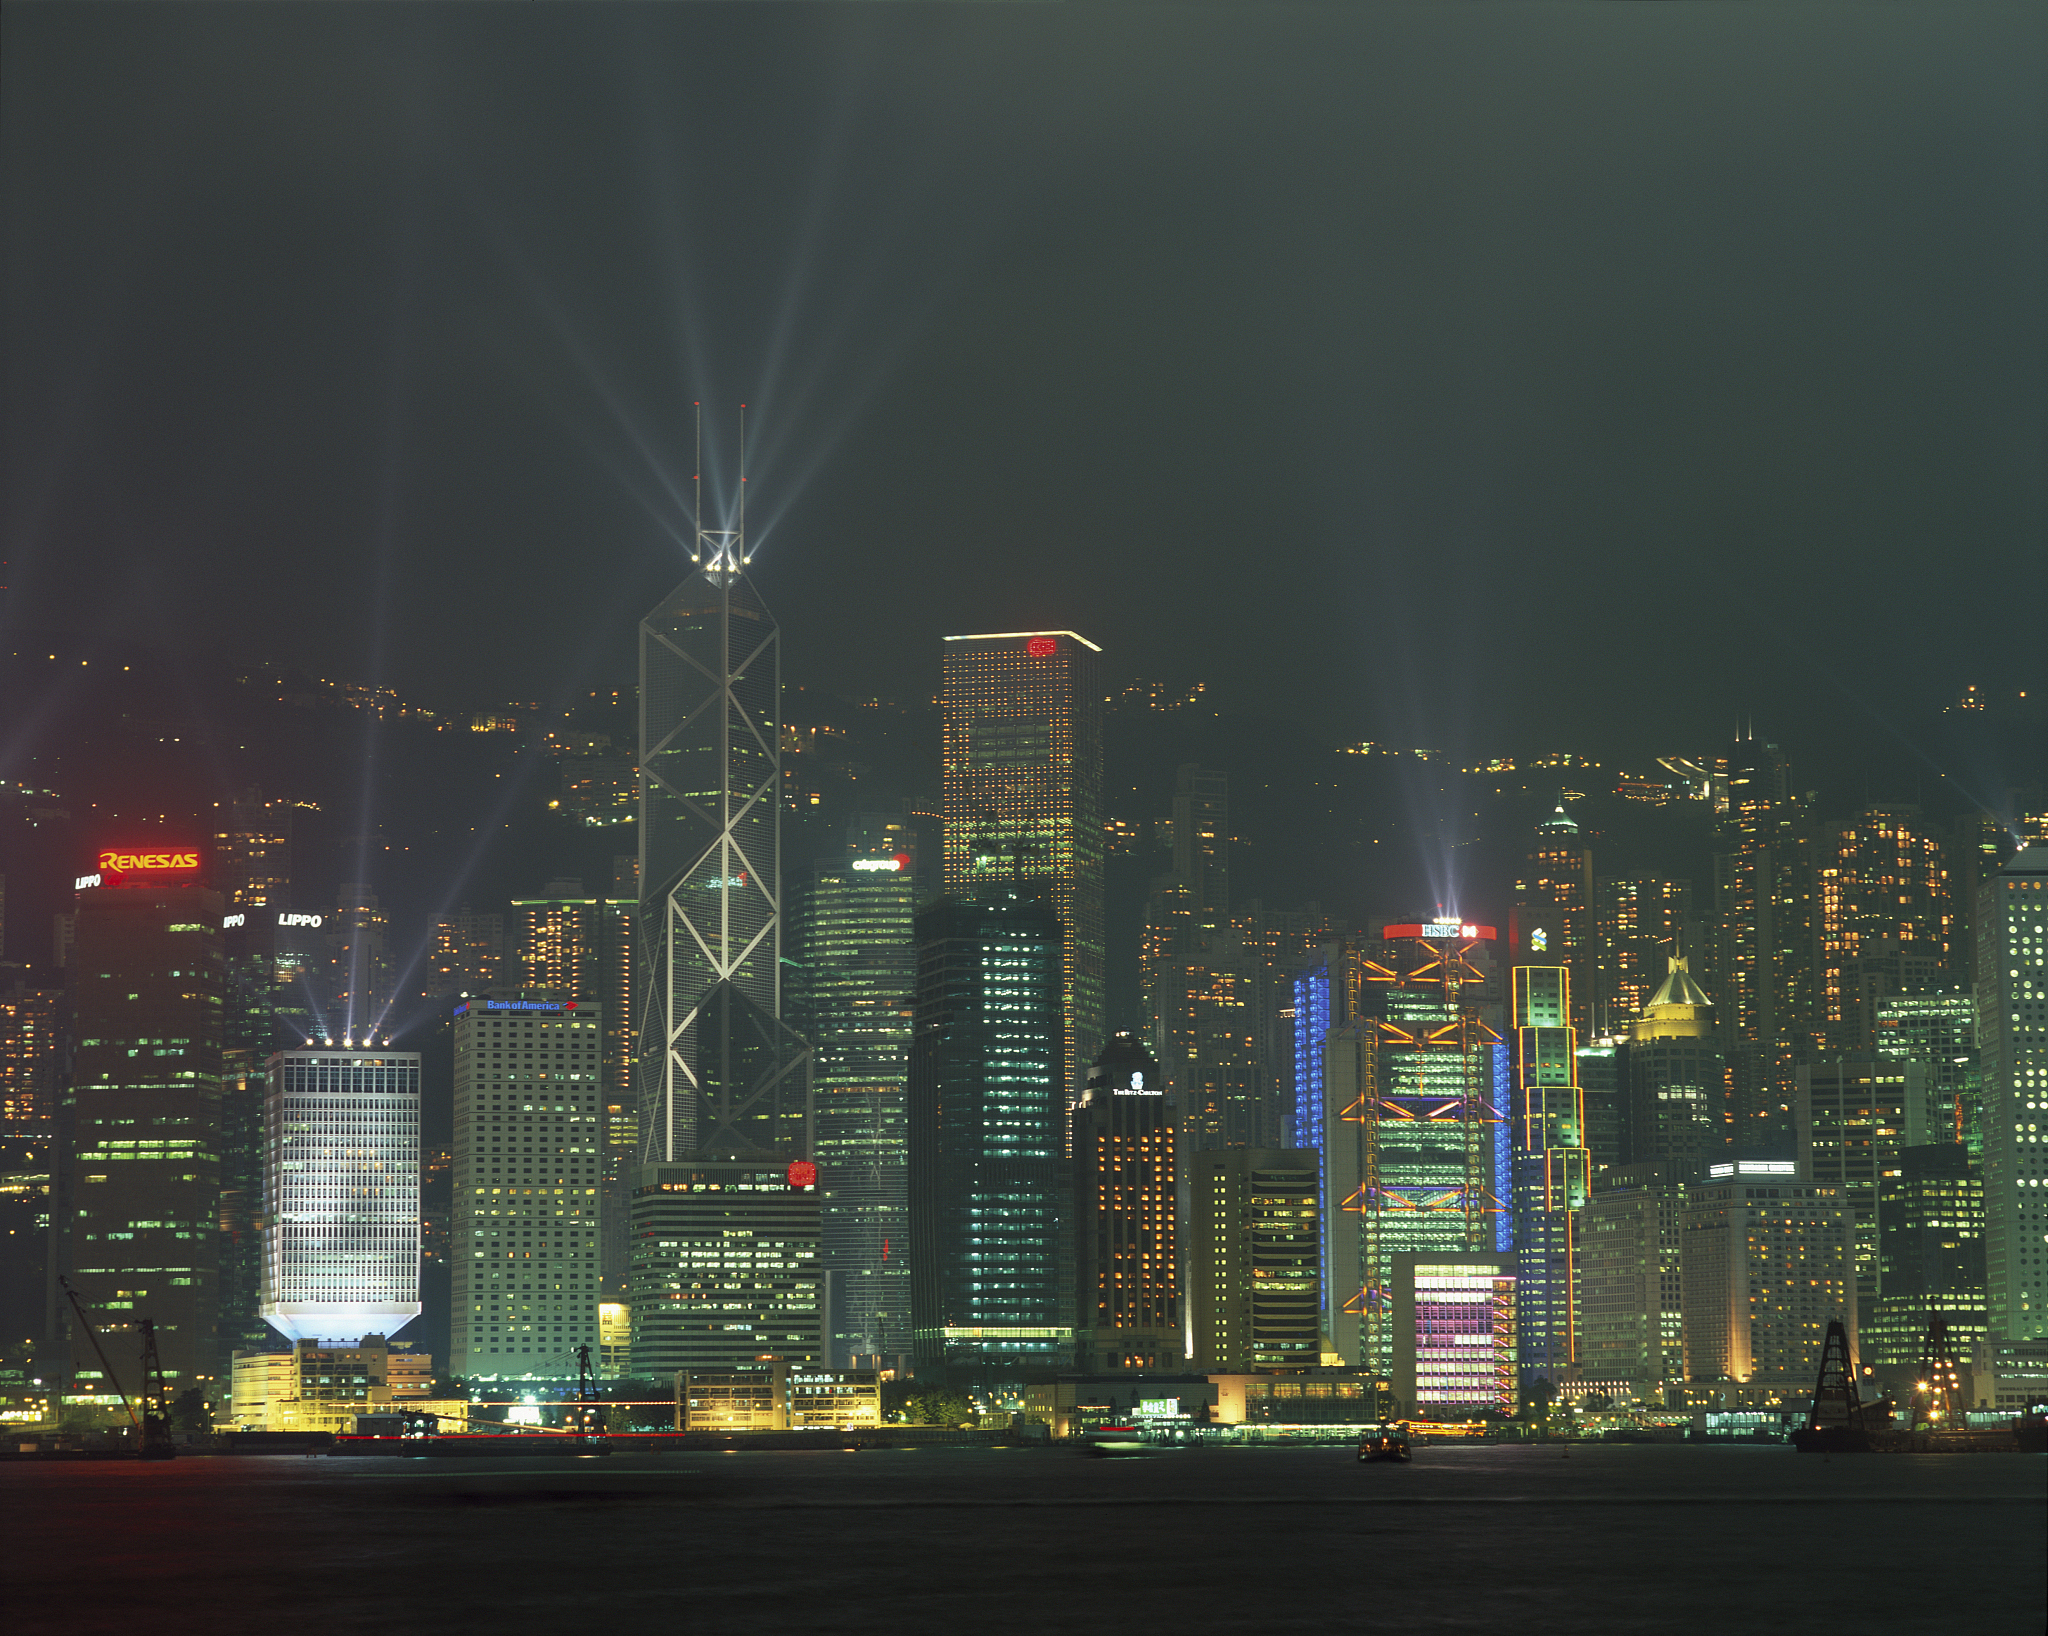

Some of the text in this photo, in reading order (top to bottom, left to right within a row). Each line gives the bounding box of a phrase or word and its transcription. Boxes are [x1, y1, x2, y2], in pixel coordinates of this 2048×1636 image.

[100, 852, 198, 873] RENESAS
[75, 874, 101, 889] LIPPO
[223, 914, 245, 928] IPPO
[278, 913, 322, 928] LIPPO
[1421, 924, 1460, 938] HSBC
[487, 1000, 560, 1010] Bank of America
